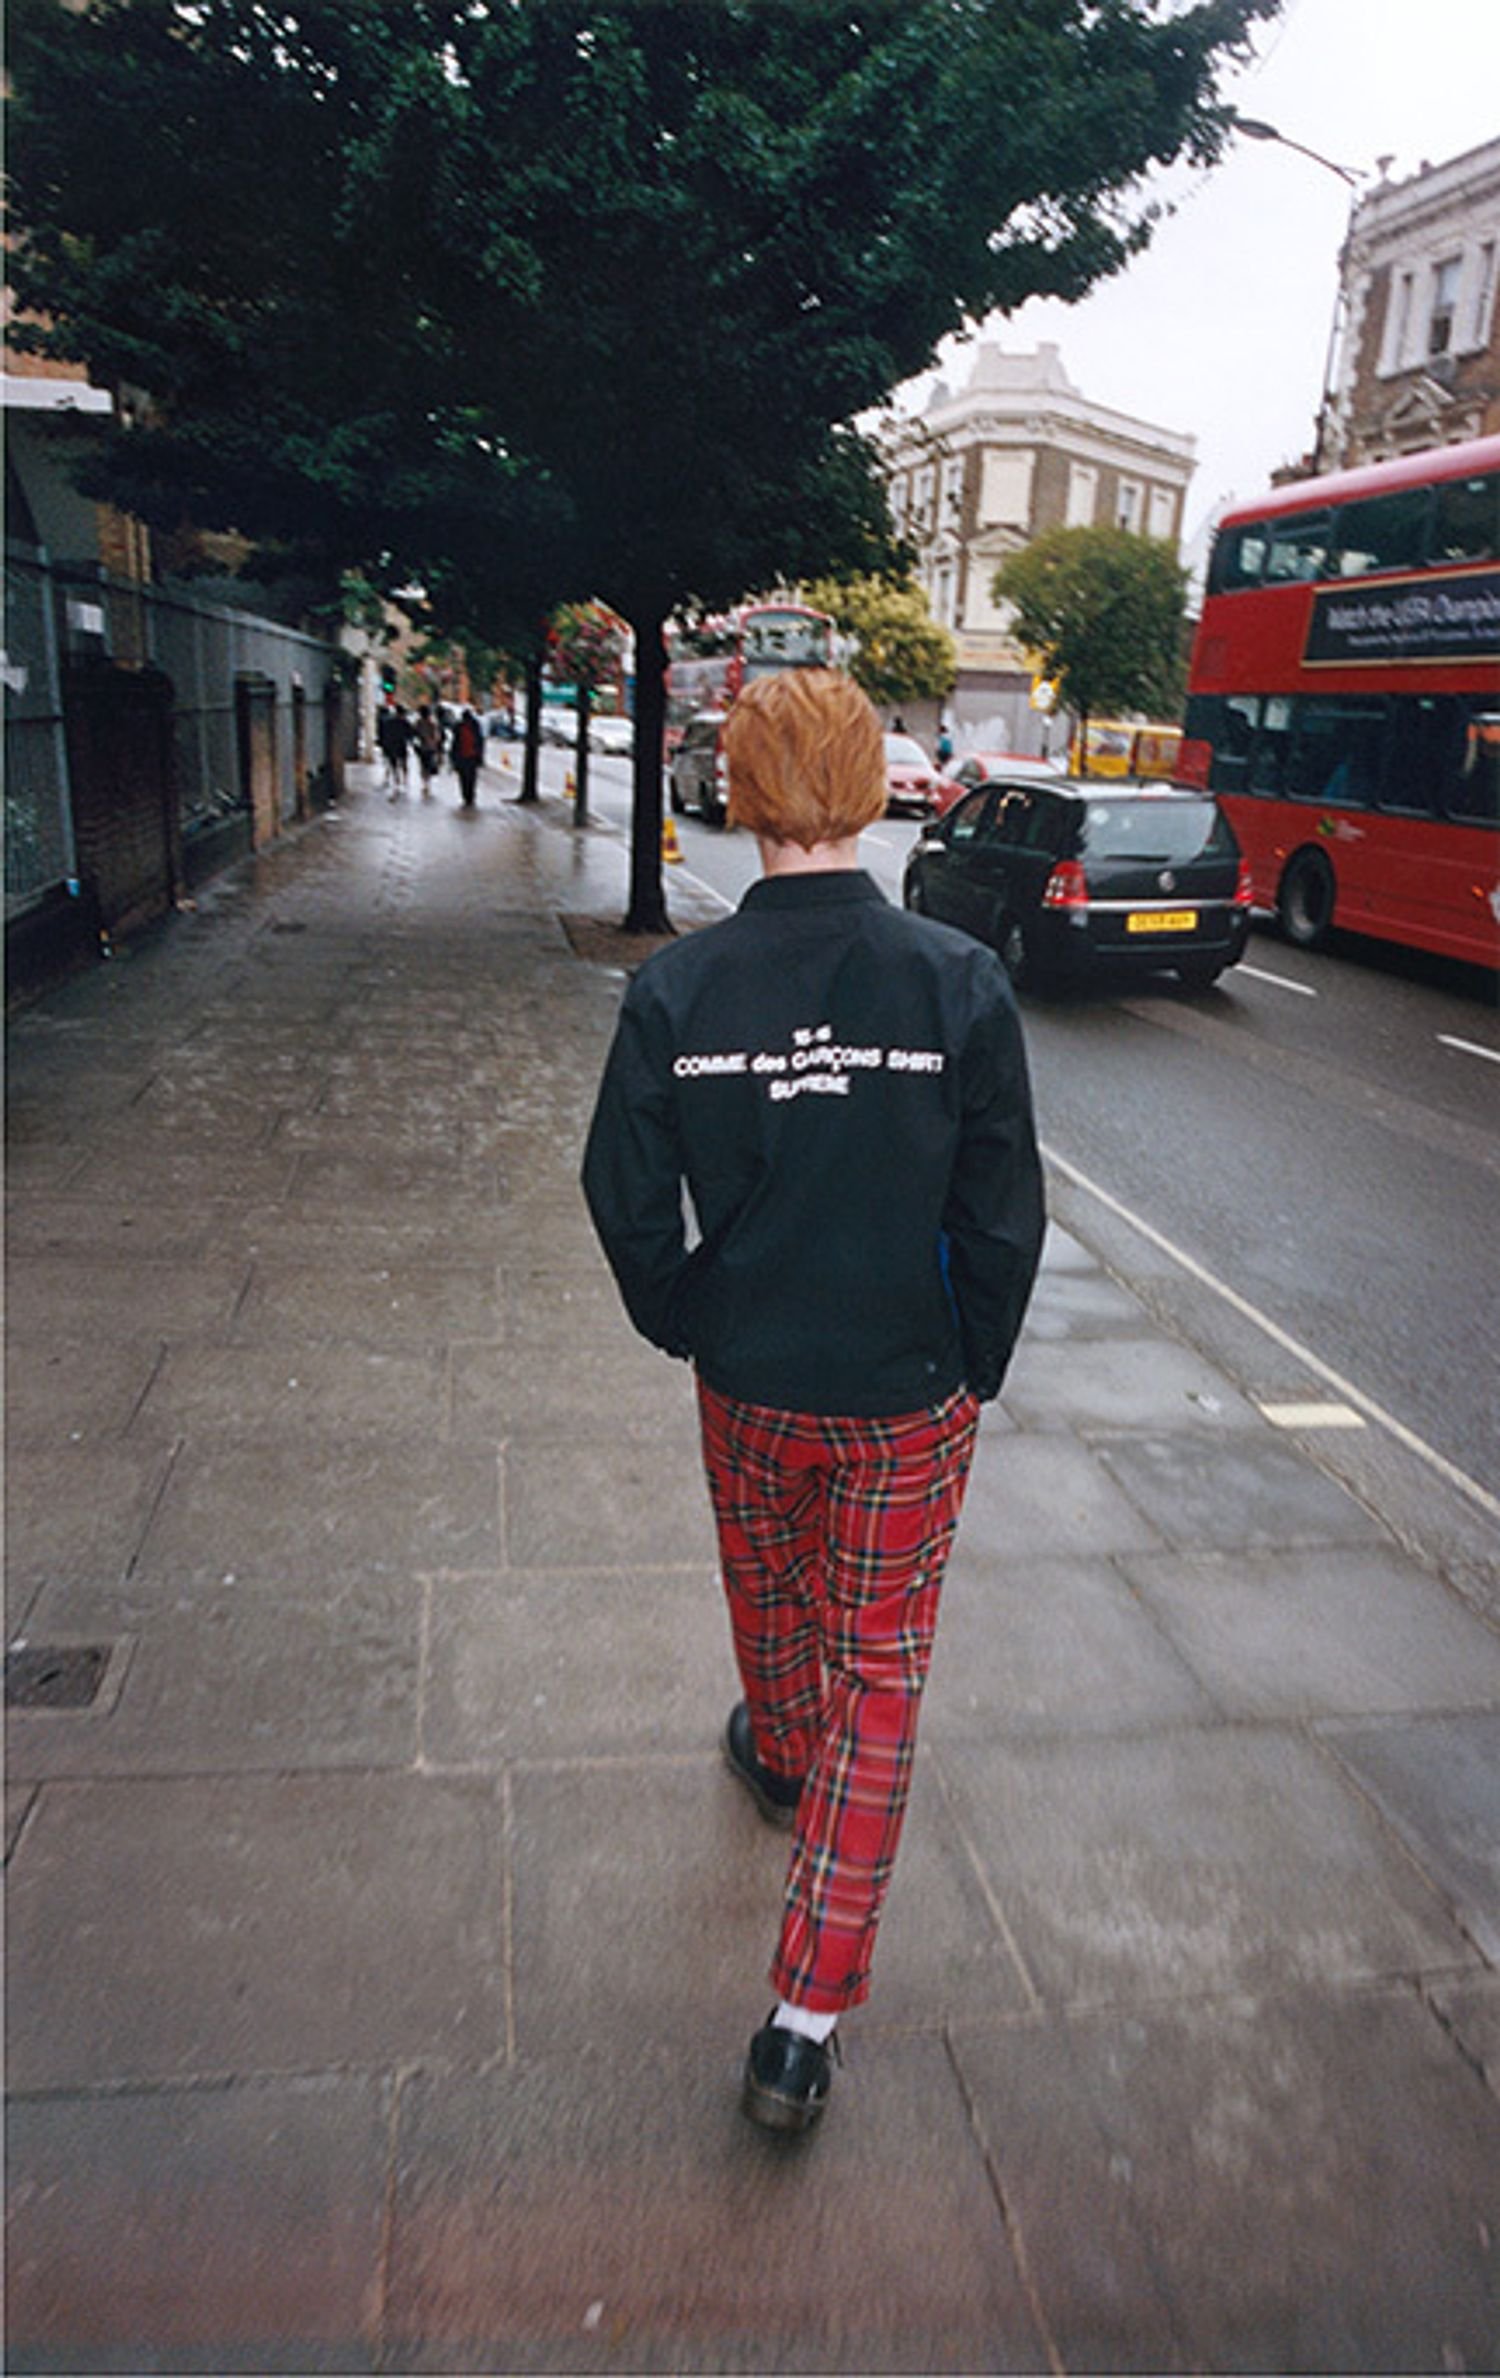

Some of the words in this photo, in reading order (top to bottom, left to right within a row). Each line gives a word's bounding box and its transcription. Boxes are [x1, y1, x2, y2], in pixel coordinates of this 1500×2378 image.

[673, 1053, 748, 1077] COMME
[751, 1052, 788, 1073] des
[791, 1046, 882, 1073] GARÇONS
[886, 1049, 944, 1073] SHIRT
[769, 1073, 850, 1101] SUPREME
